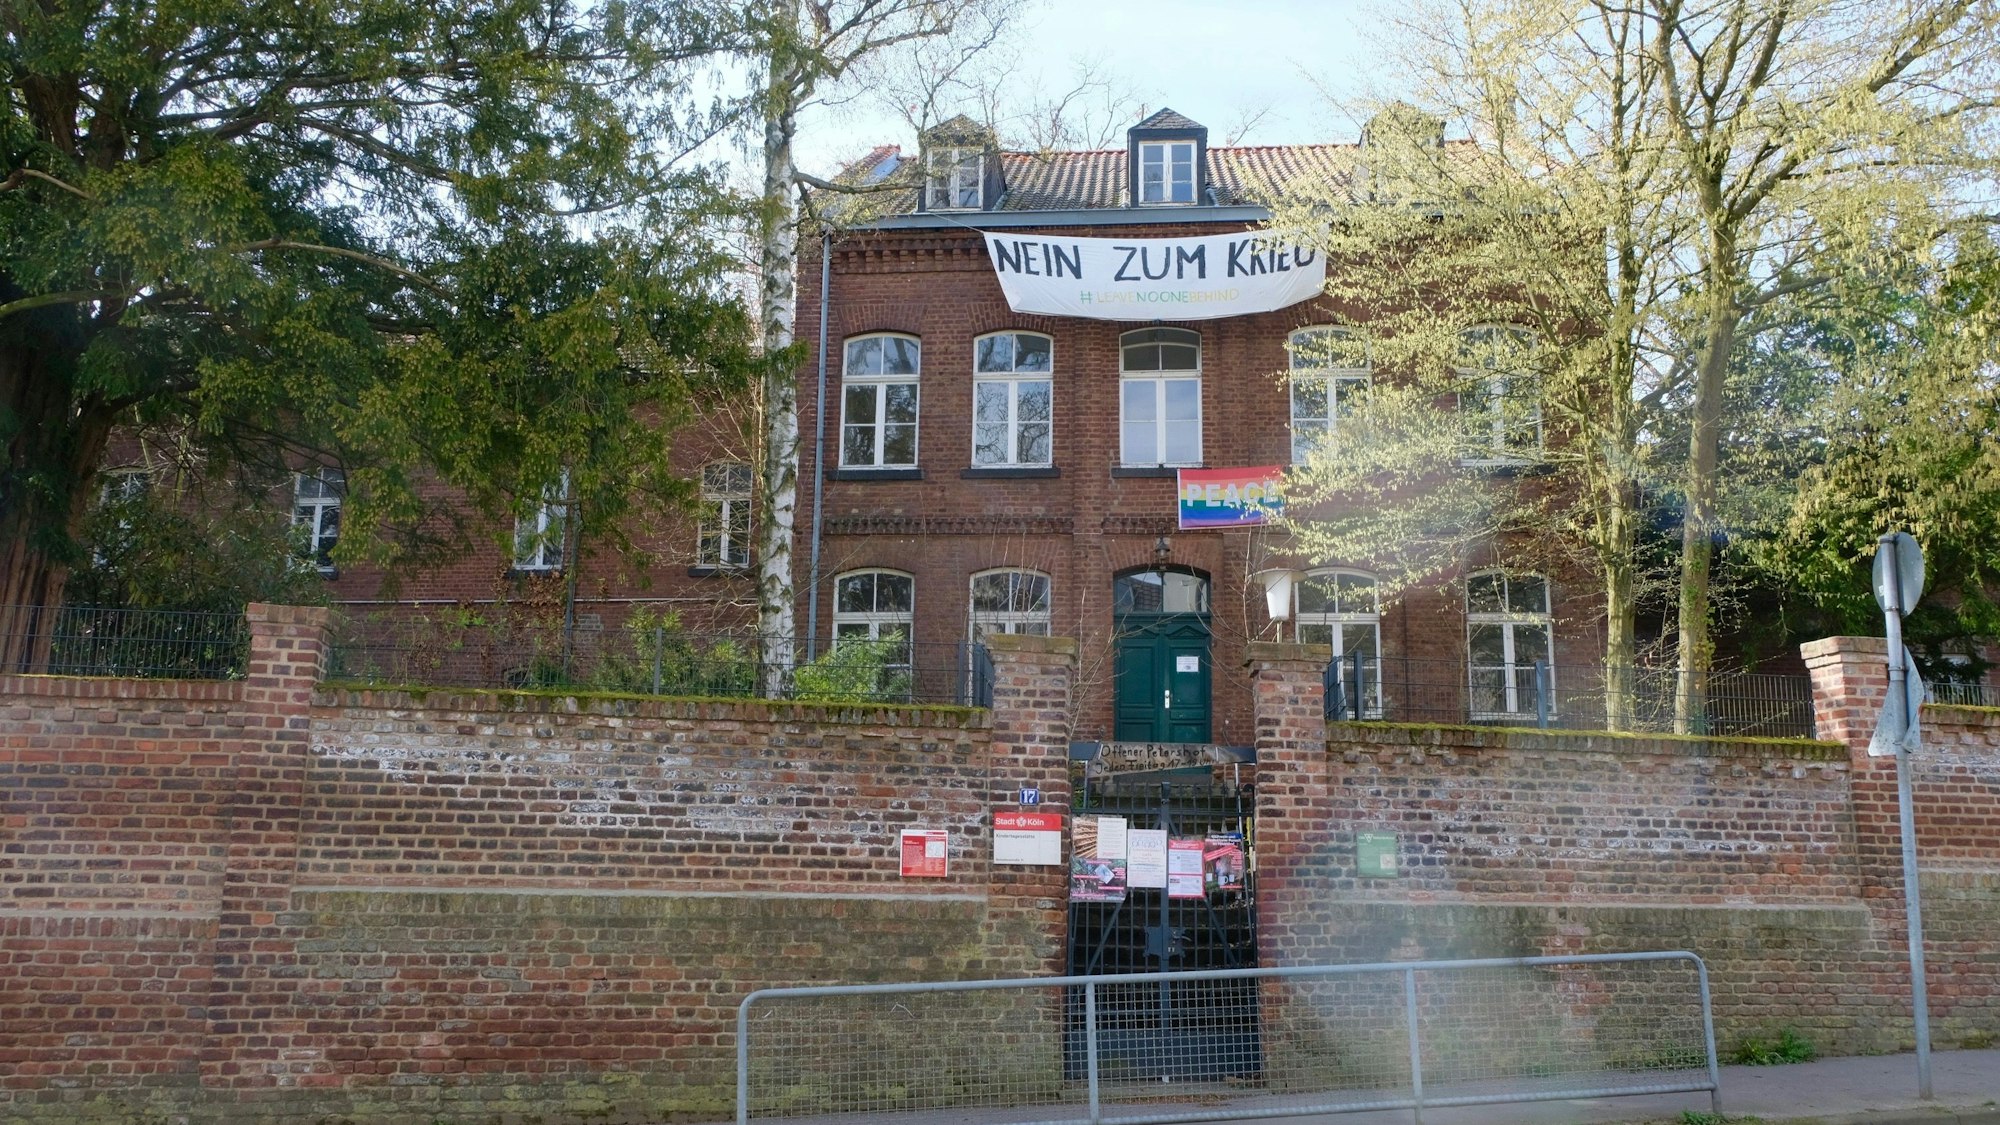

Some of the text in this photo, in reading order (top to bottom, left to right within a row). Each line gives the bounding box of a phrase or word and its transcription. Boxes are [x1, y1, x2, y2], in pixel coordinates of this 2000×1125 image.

[994, 239, 1082, 279] NEIN
[1113, 244, 1206, 282] ZUM
[1187, 480, 1278, 507] PEACE
[1101, 744, 1205, 758] Offener Petershof
[1095, 761, 1125, 774] Jeden
[1125, 759, 1165, 770] Freitag
[1023, 790, 1036, 804] 17
[995, 817, 1045, 826] Stadt Köln
